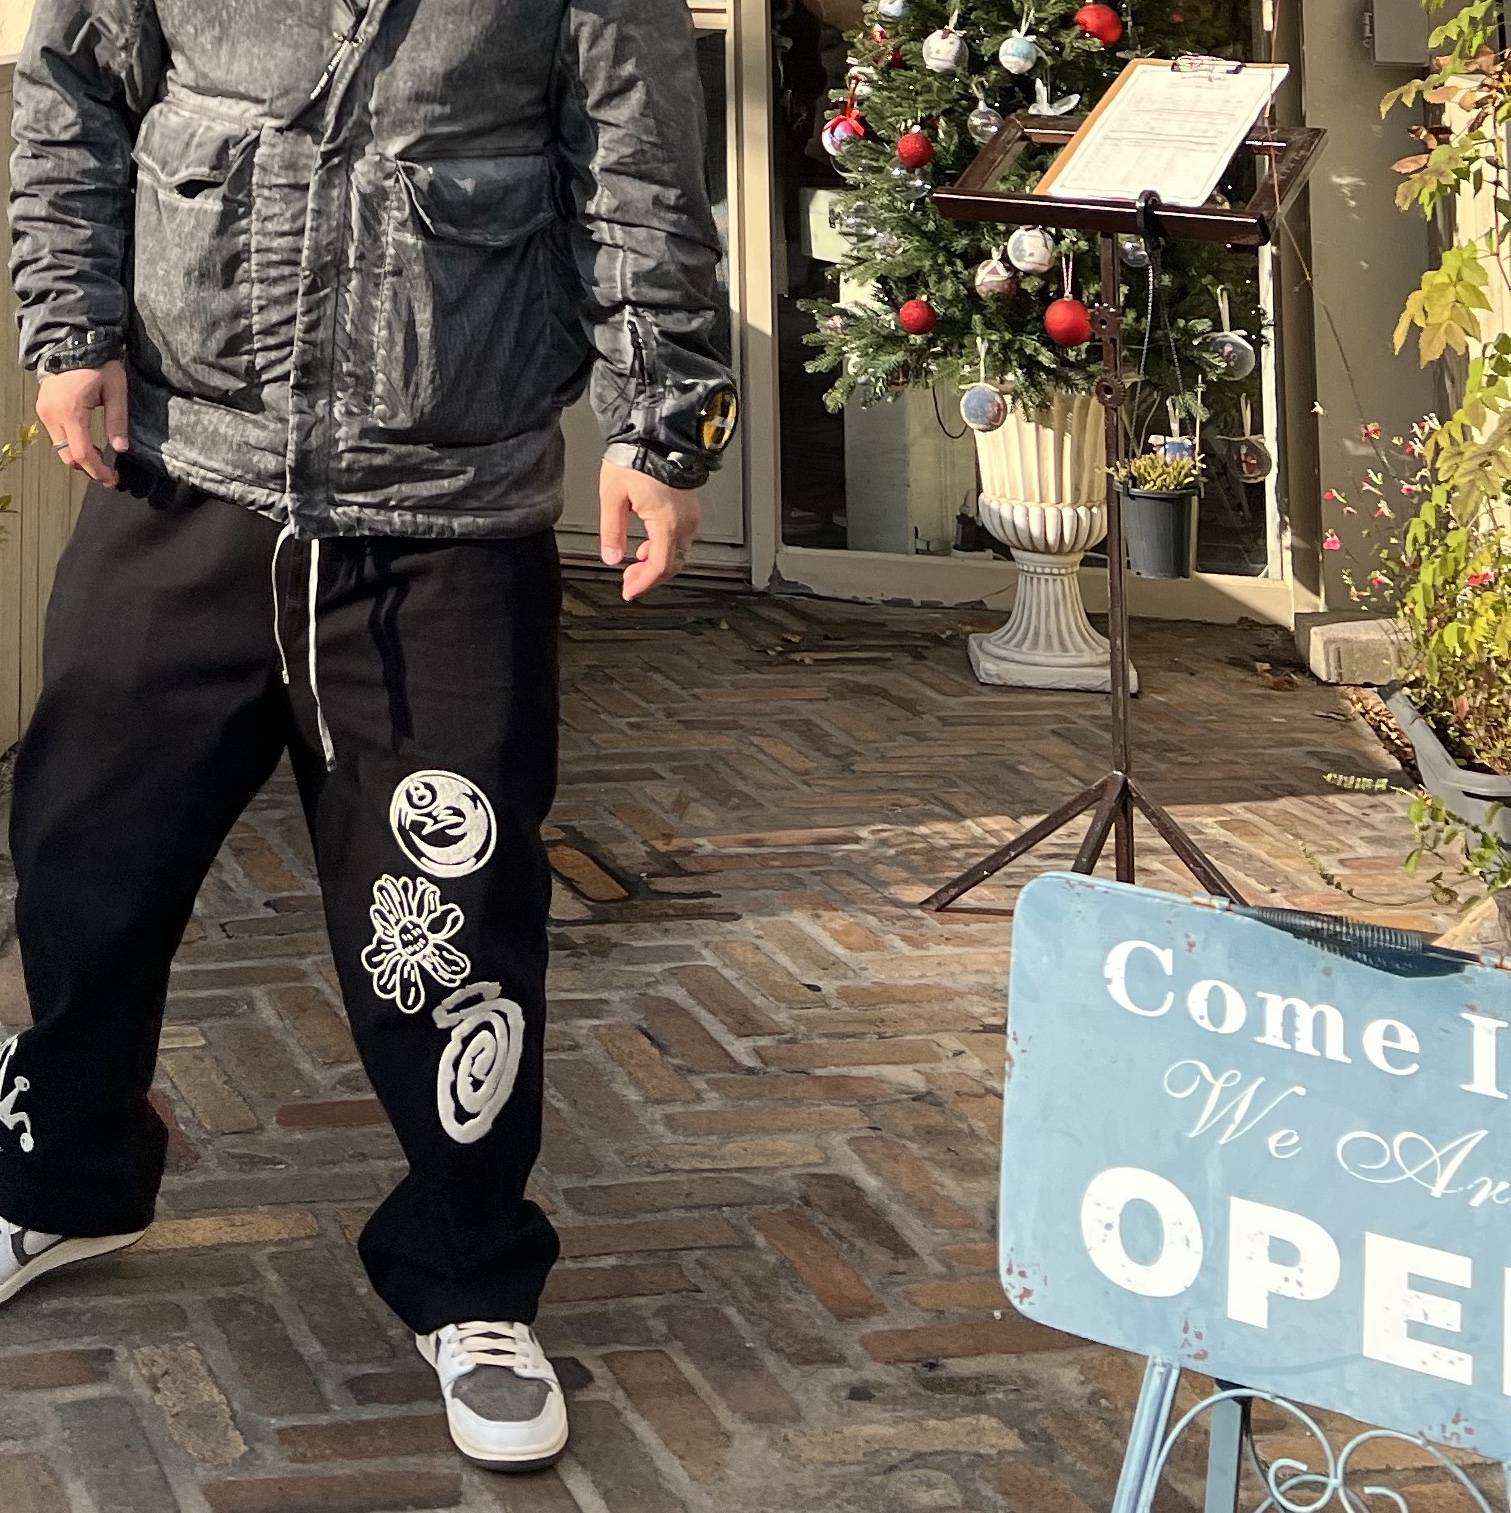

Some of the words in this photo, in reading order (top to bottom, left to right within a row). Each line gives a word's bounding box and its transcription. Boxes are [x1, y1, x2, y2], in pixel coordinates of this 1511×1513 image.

[1103, 940, 1421, 1076] Come
[1164, 1060, 1307, 1160] We
[1080, 1166, 1511, 1396] OPE
